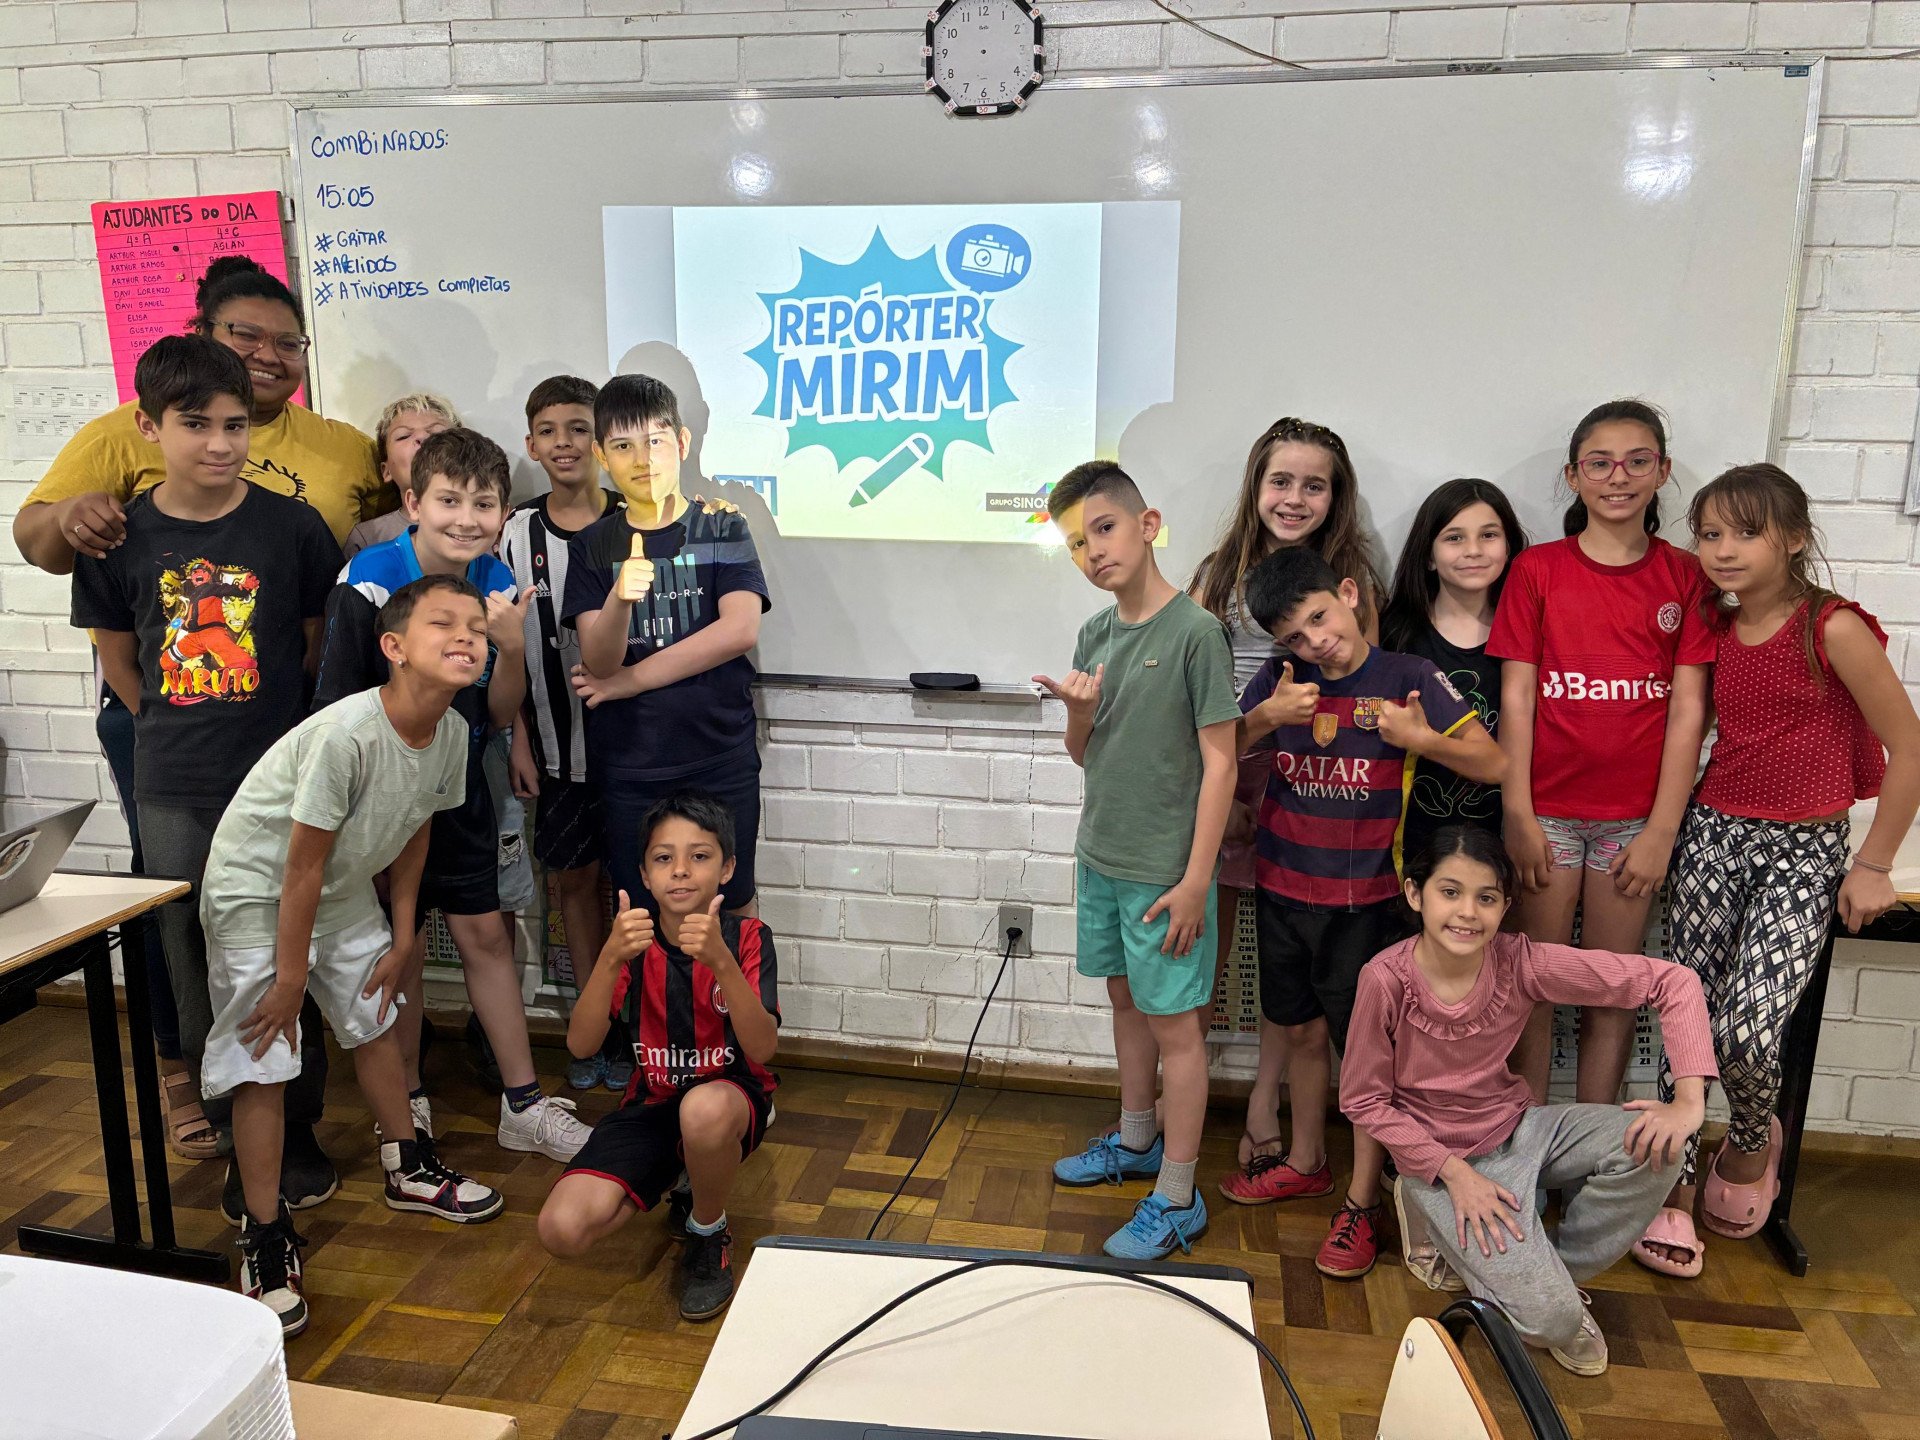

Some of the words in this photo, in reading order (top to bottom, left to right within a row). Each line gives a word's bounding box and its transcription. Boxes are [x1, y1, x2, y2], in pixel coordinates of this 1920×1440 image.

[978, 6, 989, 16] 12
[1002, 11, 1005, 20] 1
[962, 12, 970, 22] 11
[947, 28, 958, 38] 10
[1014, 24, 1021, 34] 2
[942, 48, 949, 58] 9
[947, 68, 954, 78] 8
[1013, 65, 1021, 76] 4
[962, 82, 970, 93] 7
[980, 87, 987, 97] 6
[1000, 81, 1006, 92] 5
[316, 183, 375, 208] 15:05
[103, 203, 193, 229] AJUDANTES
[227, 202, 258, 221] DIA
[213, 240, 245, 251] ASLAN
[111, 264, 137, 272] ARTHUR
[140, 260, 166, 269] RAMOS
[111, 276, 139, 285] ARTHUR
[142, 274, 163, 283] ROSA
[114, 290, 131, 298] DAVI
[137, 287, 170, 296] LORENZO
[115, 303, 133, 311] DAVI
[138, 300, 165, 309] SAMUEL
[127, 314, 148, 322] ELISA
[778, 289, 981, 347] REPÓRTER
[129, 326, 164, 335] GUSTAVO
[779, 349, 984, 421] MIRIM
[989, 498, 1013, 506] GRUPO
[643, 616, 674, 638] CITY
[160, 668, 260, 698] NARUTO
[1276, 751, 1370, 783] QATAR
[1291, 782, 1370, 801] AIRWAYS
[631, 1042, 736, 1068] Emirates
